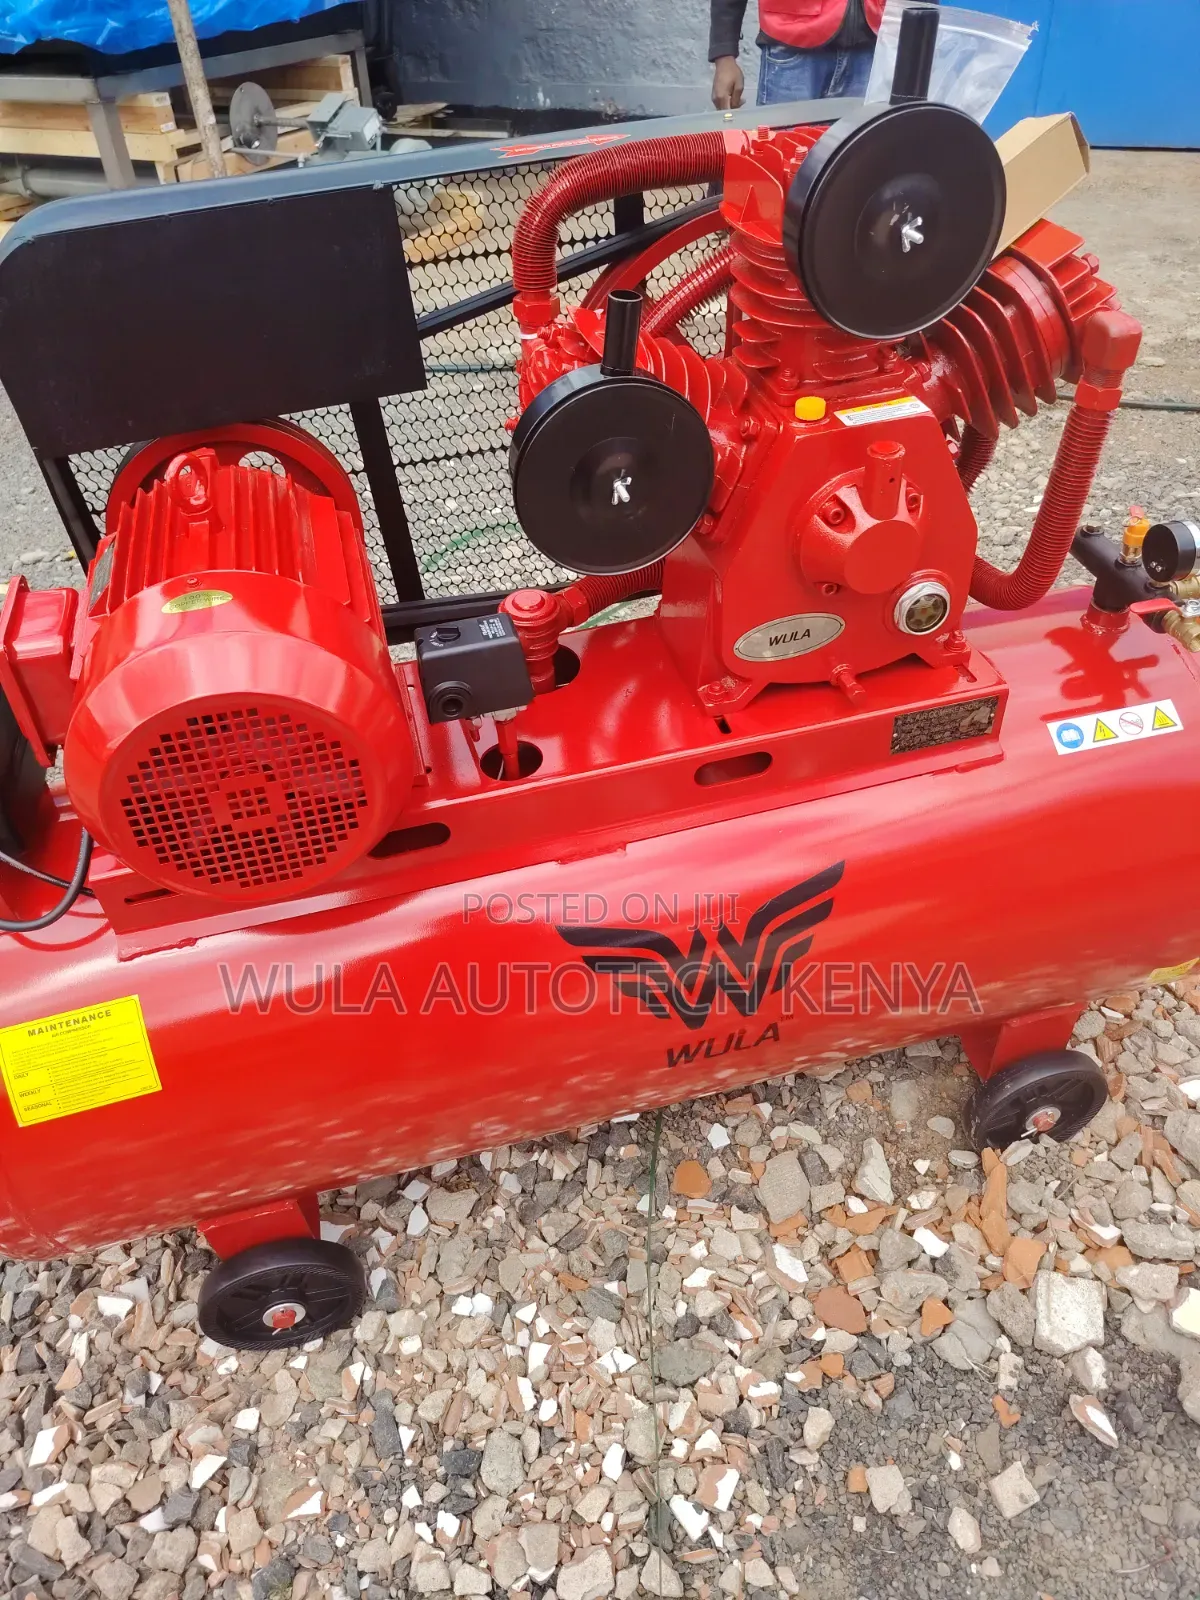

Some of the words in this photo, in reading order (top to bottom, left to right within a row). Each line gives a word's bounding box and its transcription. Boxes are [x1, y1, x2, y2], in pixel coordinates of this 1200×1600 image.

[768, 628, 811, 647] WULA
[27, 1009, 112, 1037] MAINTENANCE
[665, 1020, 781, 1068] WULA
[19, 1089, 41, 1098] WEEKLY
[23, 1101, 53, 1112] SEASONAL
